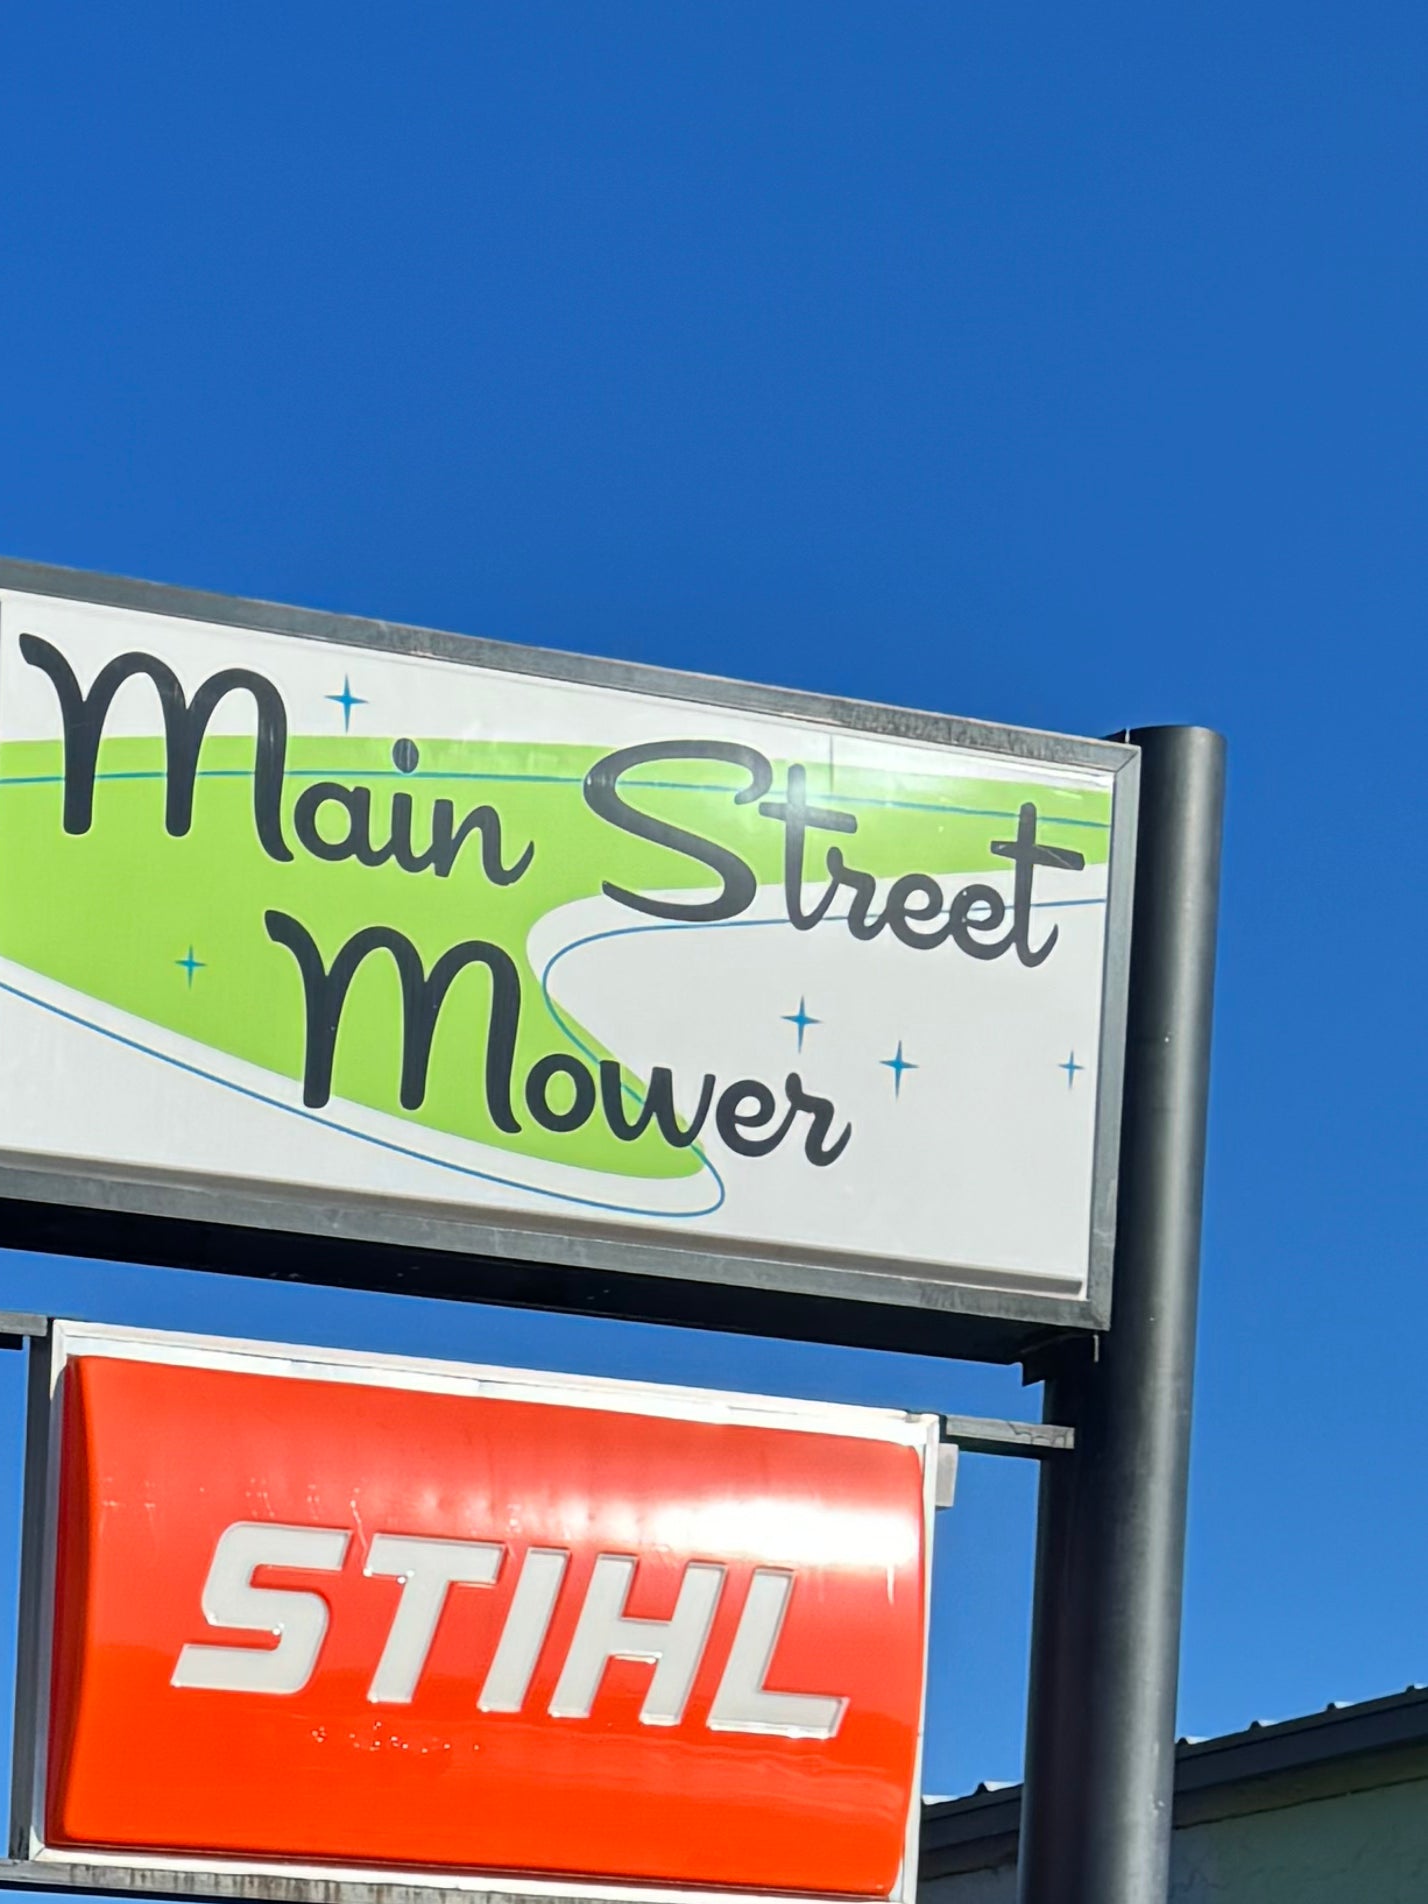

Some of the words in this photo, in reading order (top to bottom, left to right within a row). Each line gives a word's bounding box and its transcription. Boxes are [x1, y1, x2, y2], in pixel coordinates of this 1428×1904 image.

[19, 631, 534, 885] Main
[584, 739, 1084, 969] Street
[265, 910, 852, 1166] Mower
[170, 1520, 849, 1739] STIHL
